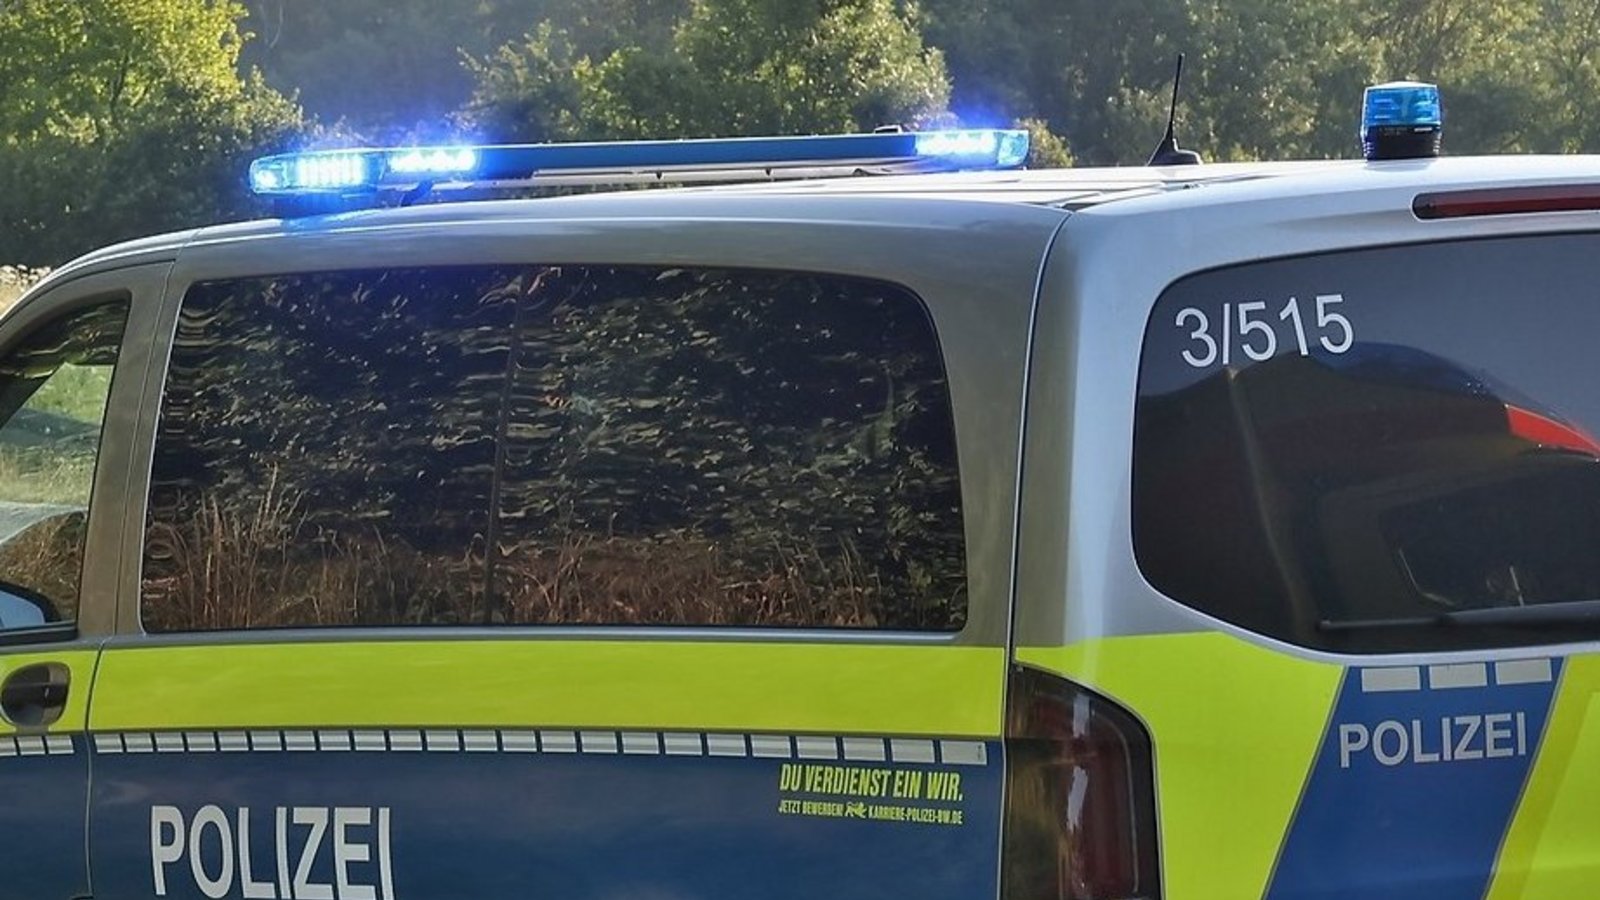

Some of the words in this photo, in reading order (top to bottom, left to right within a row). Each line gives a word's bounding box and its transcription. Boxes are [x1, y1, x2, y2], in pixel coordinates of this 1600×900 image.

[1175, 294, 1354, 367] 3/515
[1340, 712, 1526, 768] POLIZEI
[779, 800, 801, 814] JETZT
[780, 764, 802, 791] DU
[804, 766, 891, 797] VERDIENST
[894, 771, 921, 799] EIN
[926, 773, 963, 801] WIR.
[151, 804, 394, 900] POLIZEI
